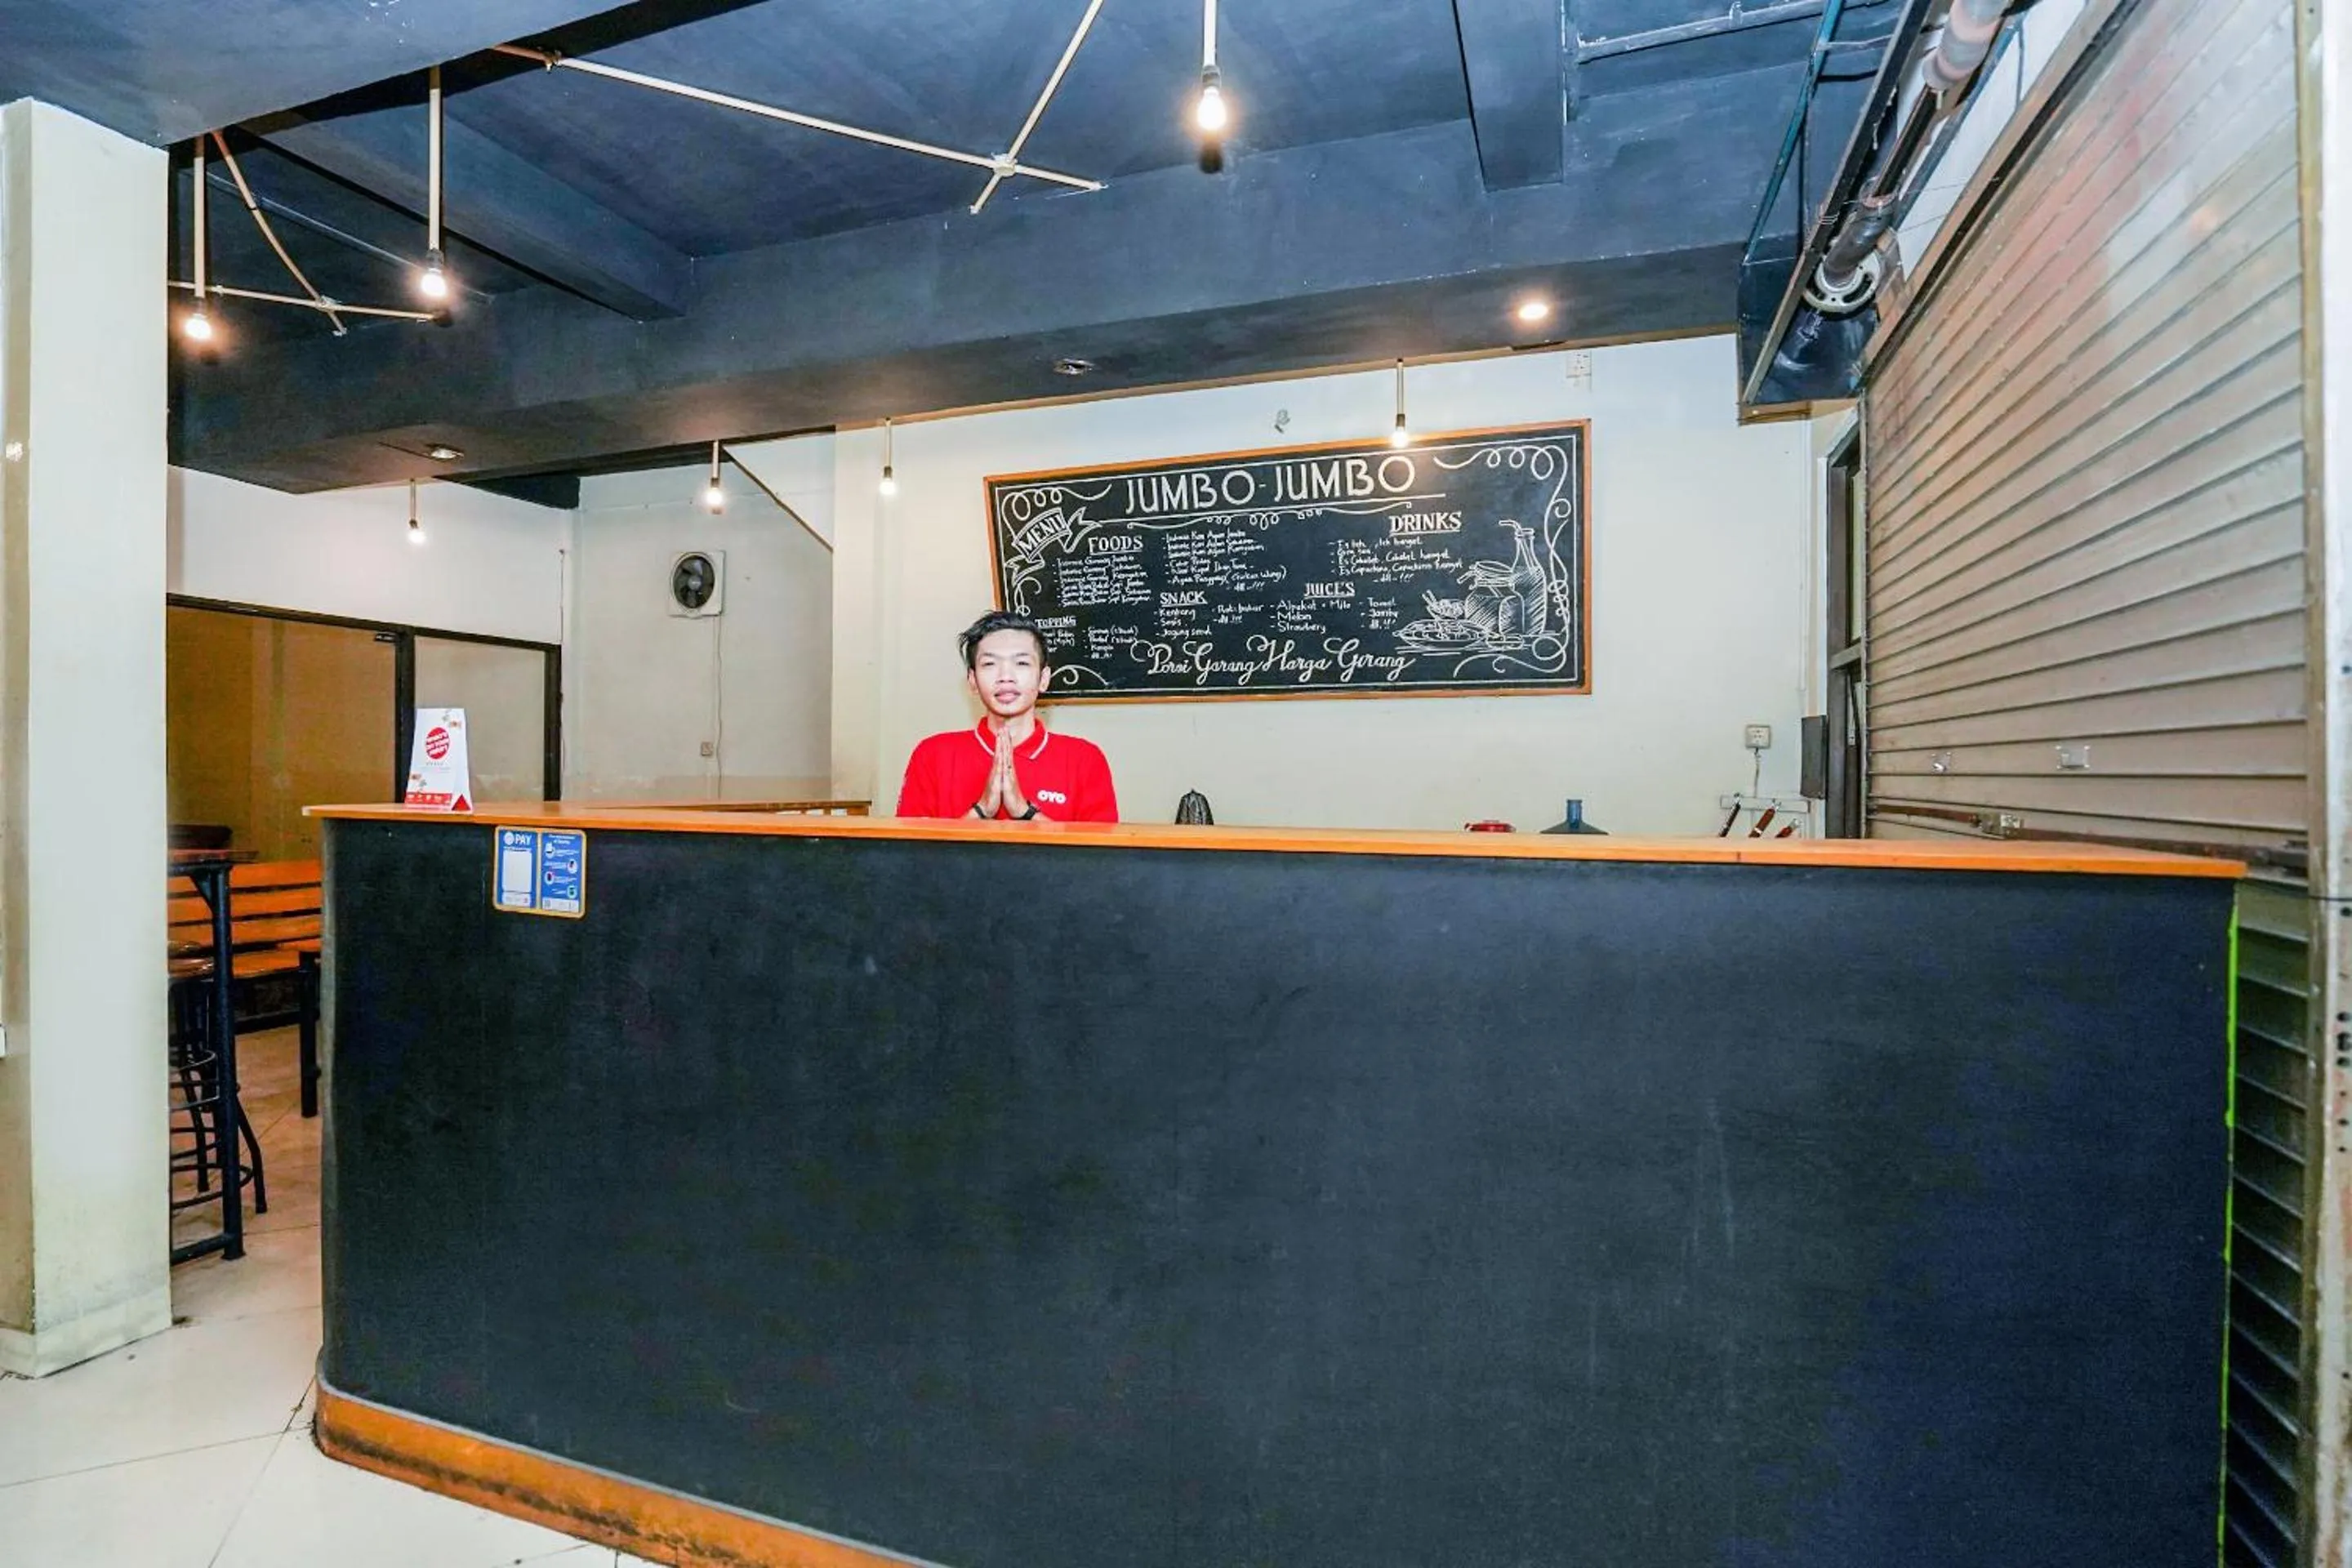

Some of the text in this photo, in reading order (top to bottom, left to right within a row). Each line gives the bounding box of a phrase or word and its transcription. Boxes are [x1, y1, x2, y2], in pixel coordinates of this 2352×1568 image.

[1389, 511, 1462, 533] DRINKS
[1018, 514, 1066, 555] MENU
[1088, 535, 1143, 555] FOODS
[1160, 591, 1208, 605] SNACK
[1034, 615, 1076, 628] TOPPING
[1183, 640, 1263, 686] Garang
[1246, 635, 1332, 683] Harga
[515, 833, 532, 845] PAY
